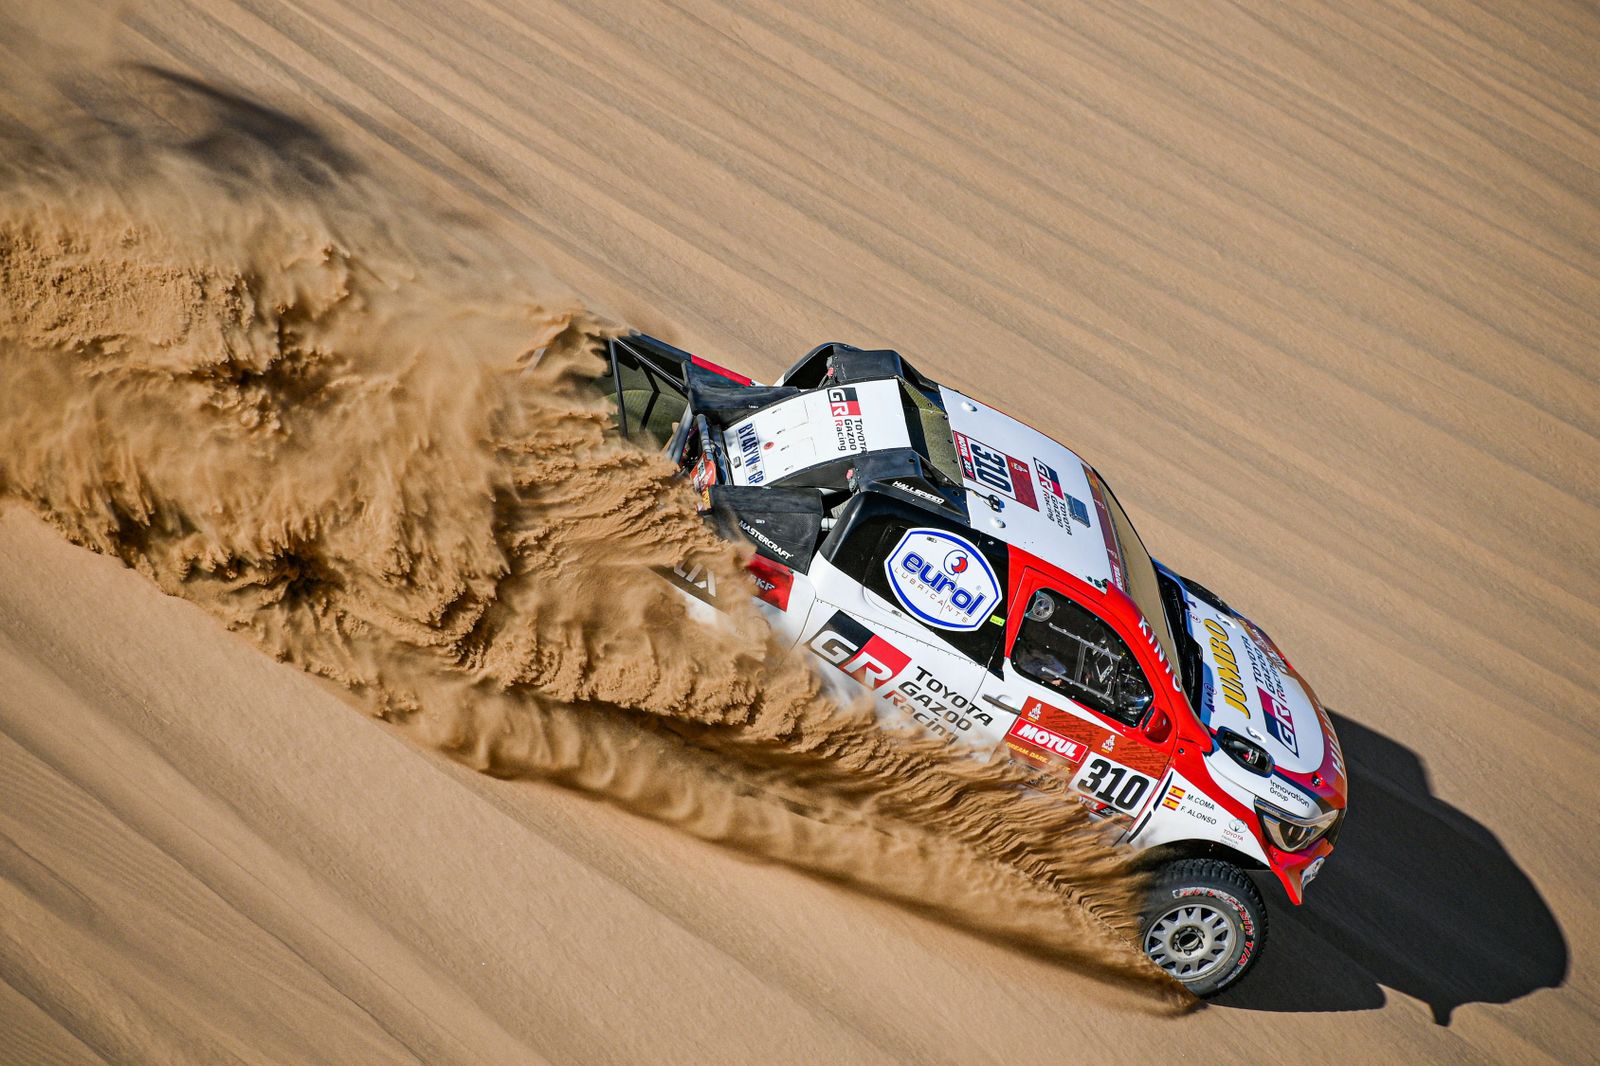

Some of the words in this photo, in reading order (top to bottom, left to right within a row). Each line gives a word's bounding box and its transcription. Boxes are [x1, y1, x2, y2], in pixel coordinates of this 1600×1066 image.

[829, 389, 849, 416] GR
[835, 419, 846, 451] Racing
[844, 418, 857, 450] GAZOO
[970, 443, 1012, 492] 310
[1035, 460, 1054, 493] GR
[892, 480, 944, 504] HALLSPEED
[1042, 489, 1055, 522] Racing
[1051, 494, 1064, 528] GAZOO
[1059, 501, 1072, 536] TOYOTA
[738, 520, 791, 559] MASTERCRAFT
[894, 567, 968, 623] LUBRICANTS
[901, 551, 986, 617] eurol
[810, 630, 893, 688] GR
[1203, 618, 1251, 719] JUMBO
[1241, 635, 1264, 683] TOYOTA
[1254, 647, 1276, 694] GAZOO
[915, 665, 993, 726] TOYOTA
[1266, 657, 1287, 703] Racing
[898, 681, 972, 731] GAZOO
[1017, 723, 1077, 757] MOTUL
[1077, 758, 1149, 810] 310
[1269, 787, 1289, 802] Group
[1270, 779, 1310, 808] Innovation
[1180, 805, 1186, 813] F.
[1187, 809, 1217, 825] ALONSO
[1187, 794, 1215, 810] M.COMA
[1223, 829, 1244, 841] TOYOTA
